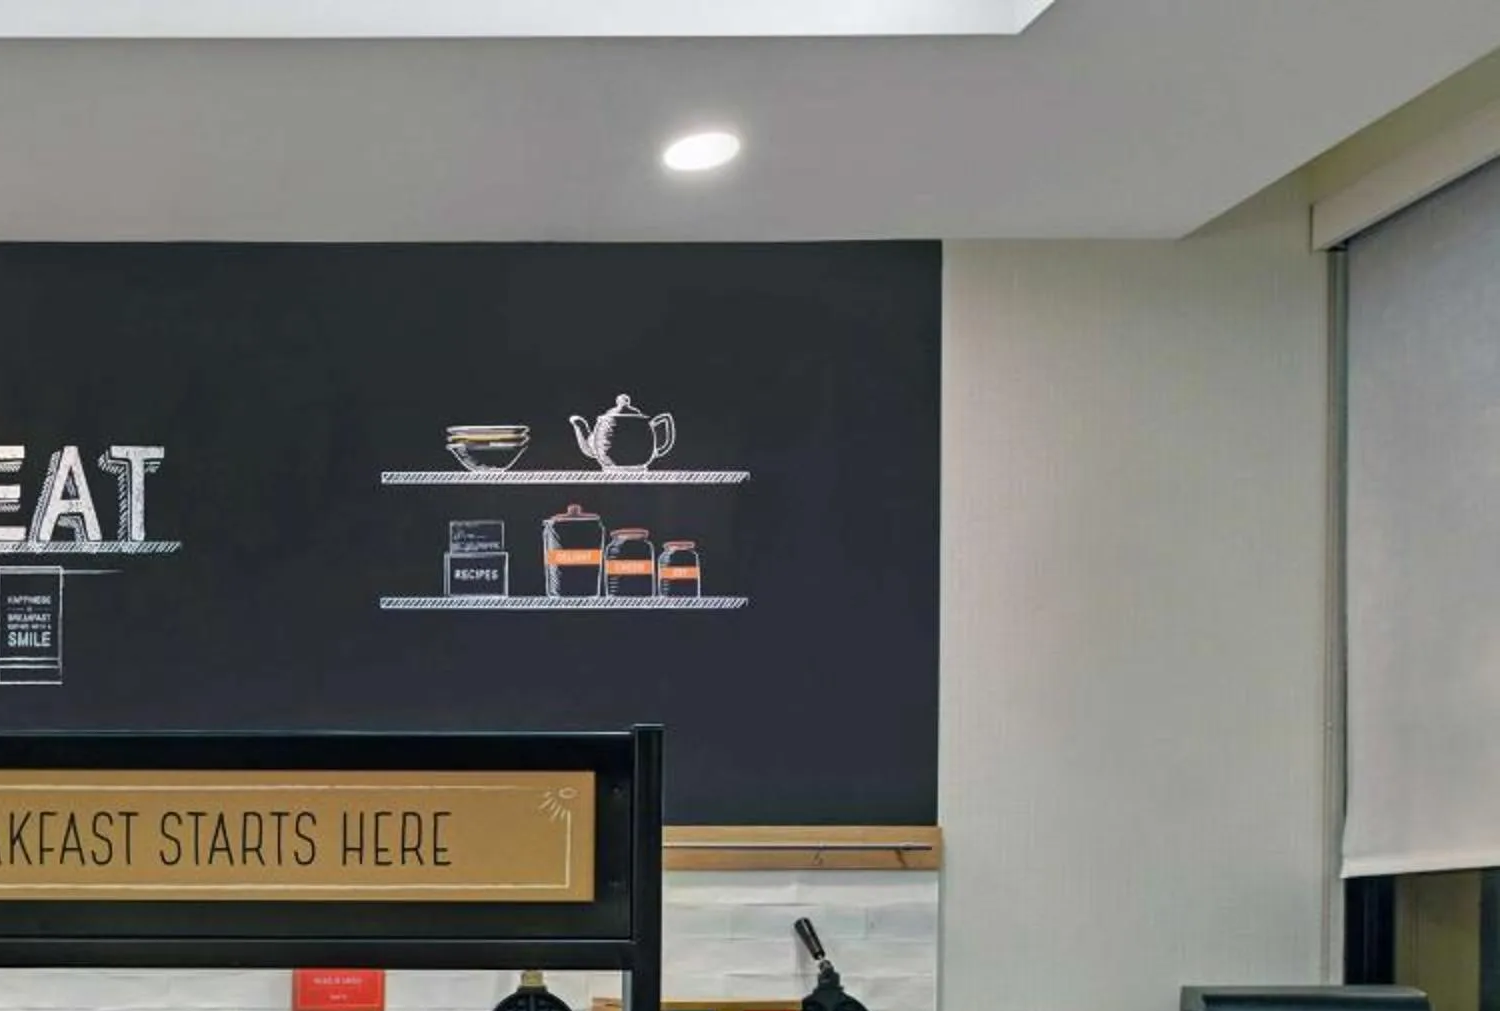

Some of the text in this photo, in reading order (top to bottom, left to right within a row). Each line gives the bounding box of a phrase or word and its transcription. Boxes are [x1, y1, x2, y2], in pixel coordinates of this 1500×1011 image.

[454, 569, 499, 581] RECIPES
[8, 631, 51, 648] SMILE
[159, 811, 318, 866] STARTS
[341, 811, 453, 866] HERE
